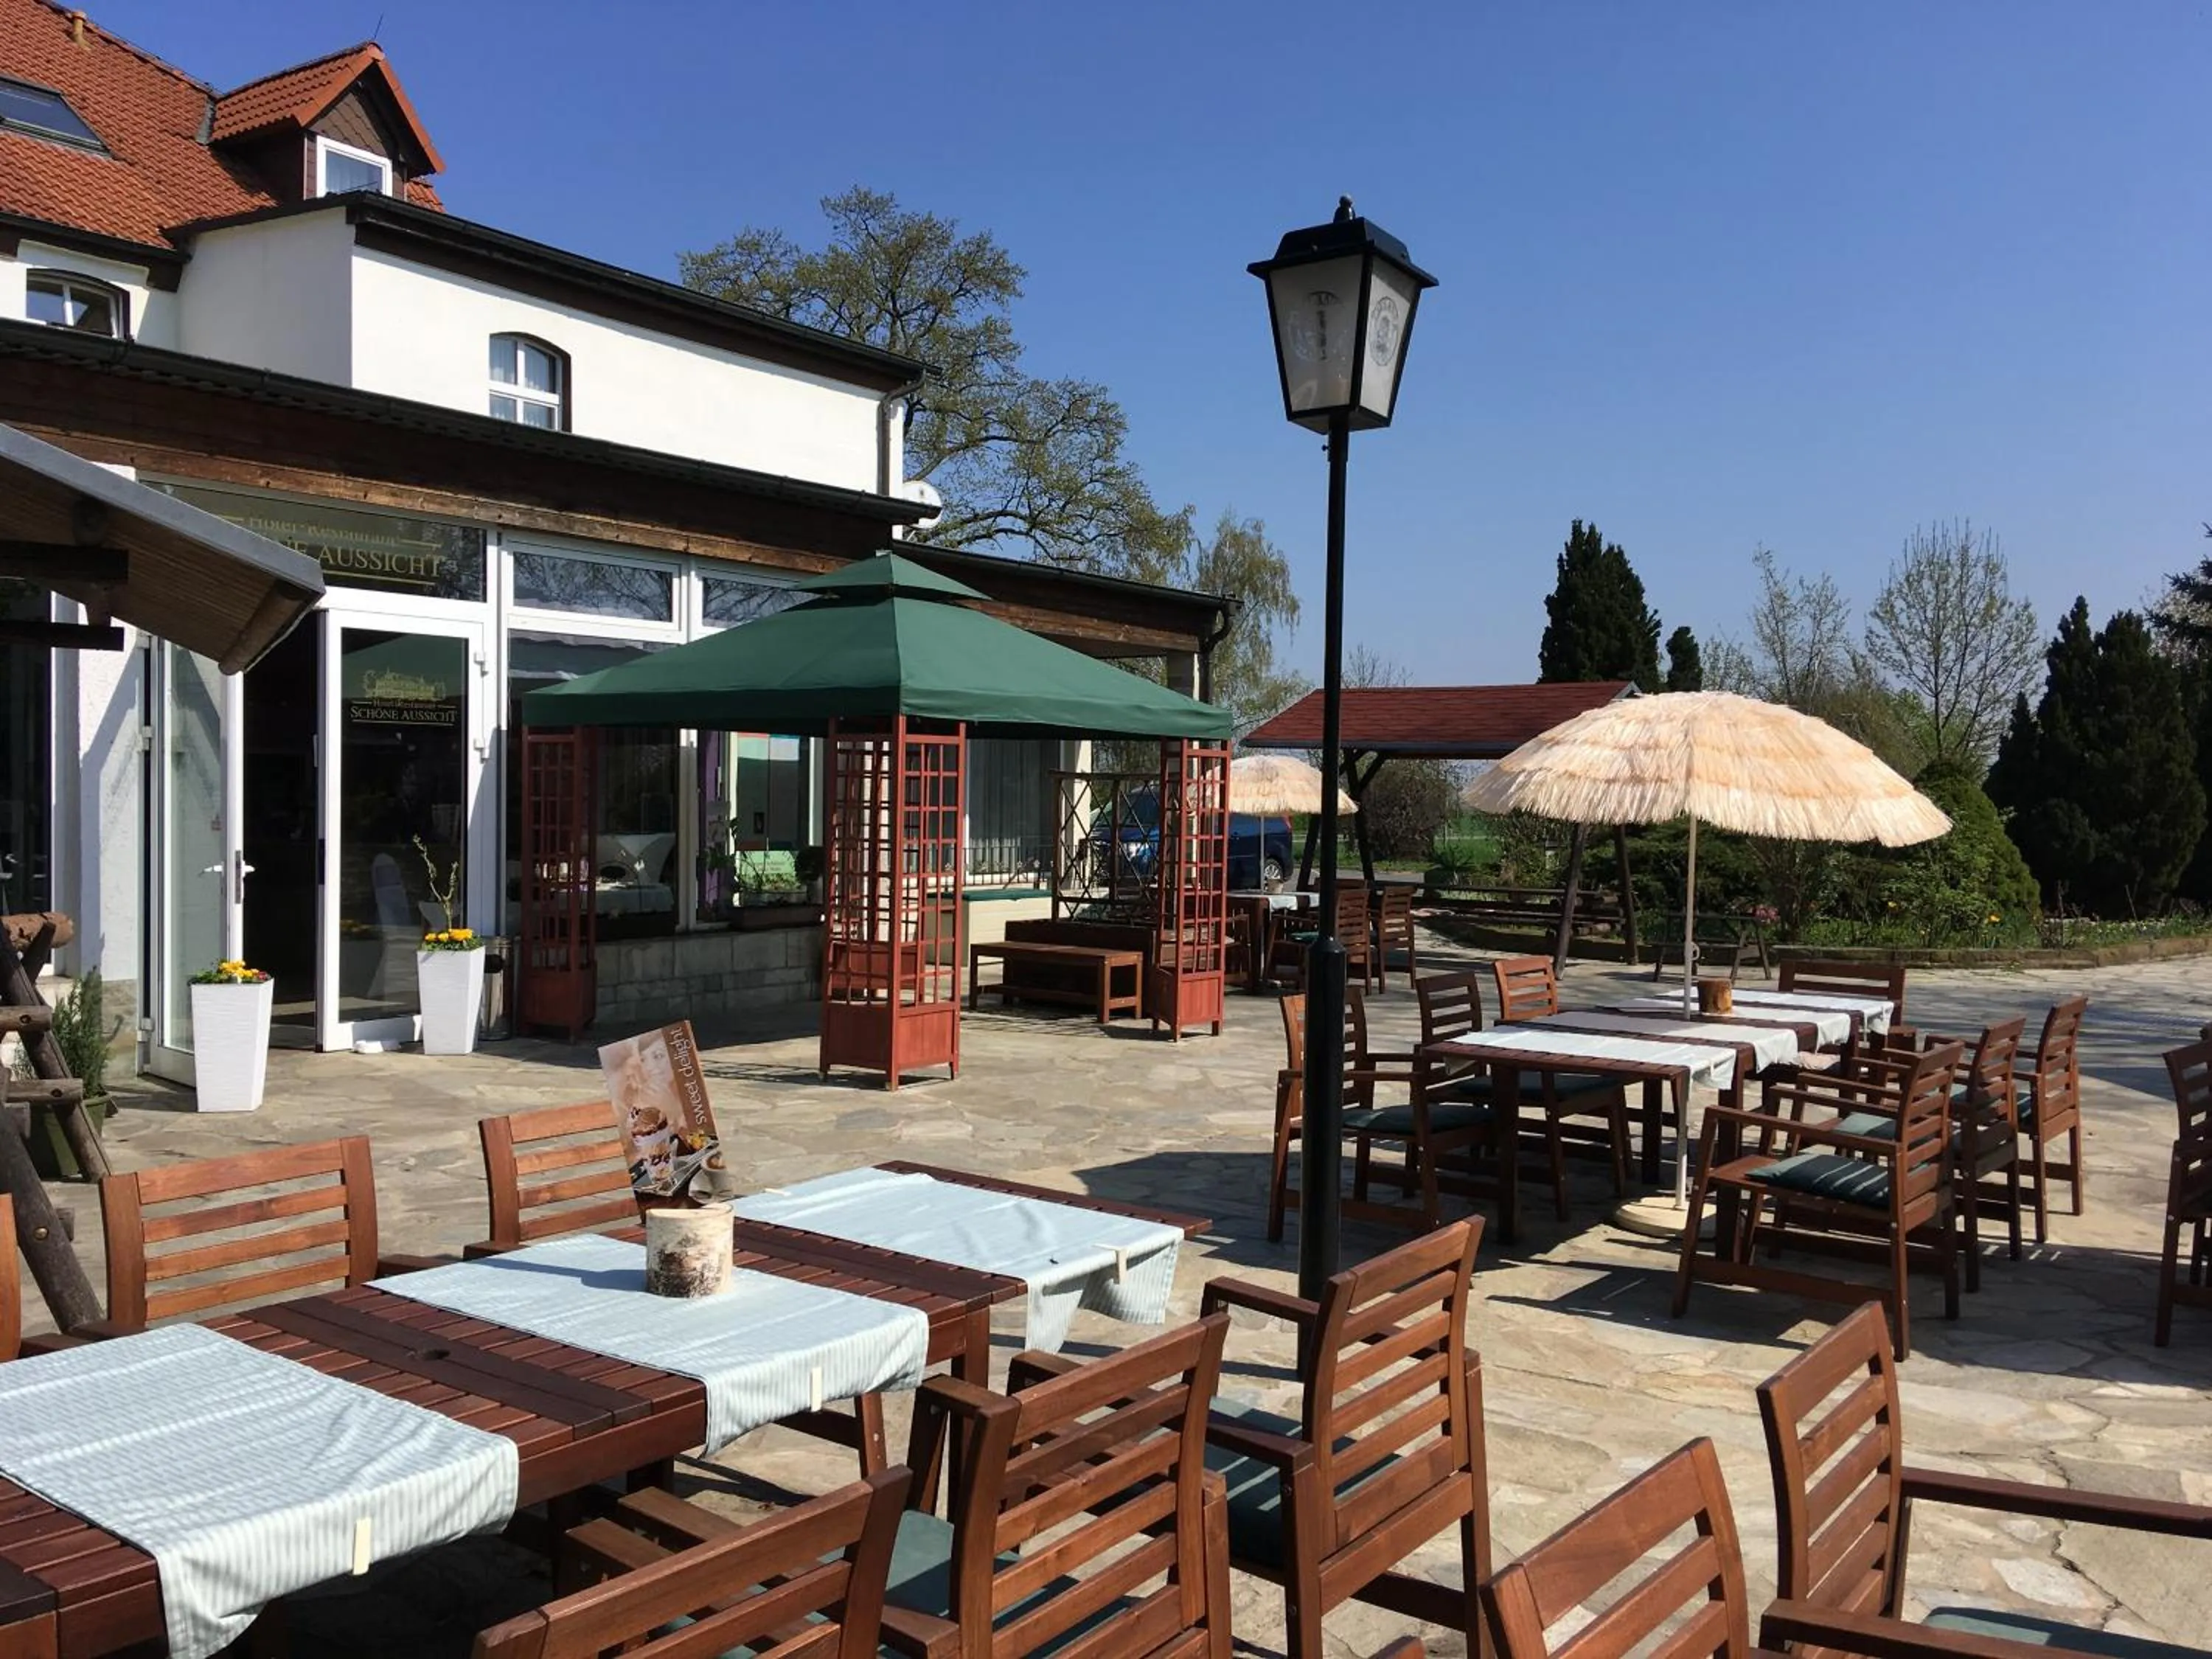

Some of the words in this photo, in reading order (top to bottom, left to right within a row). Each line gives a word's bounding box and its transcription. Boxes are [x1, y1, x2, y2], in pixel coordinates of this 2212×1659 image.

[318, 544, 446, 577] AUSSICHT
[401, 709, 457, 723] AUSSICHT
[669, 1026, 694, 1077] delight
[684, 1079, 707, 1125] sweet
